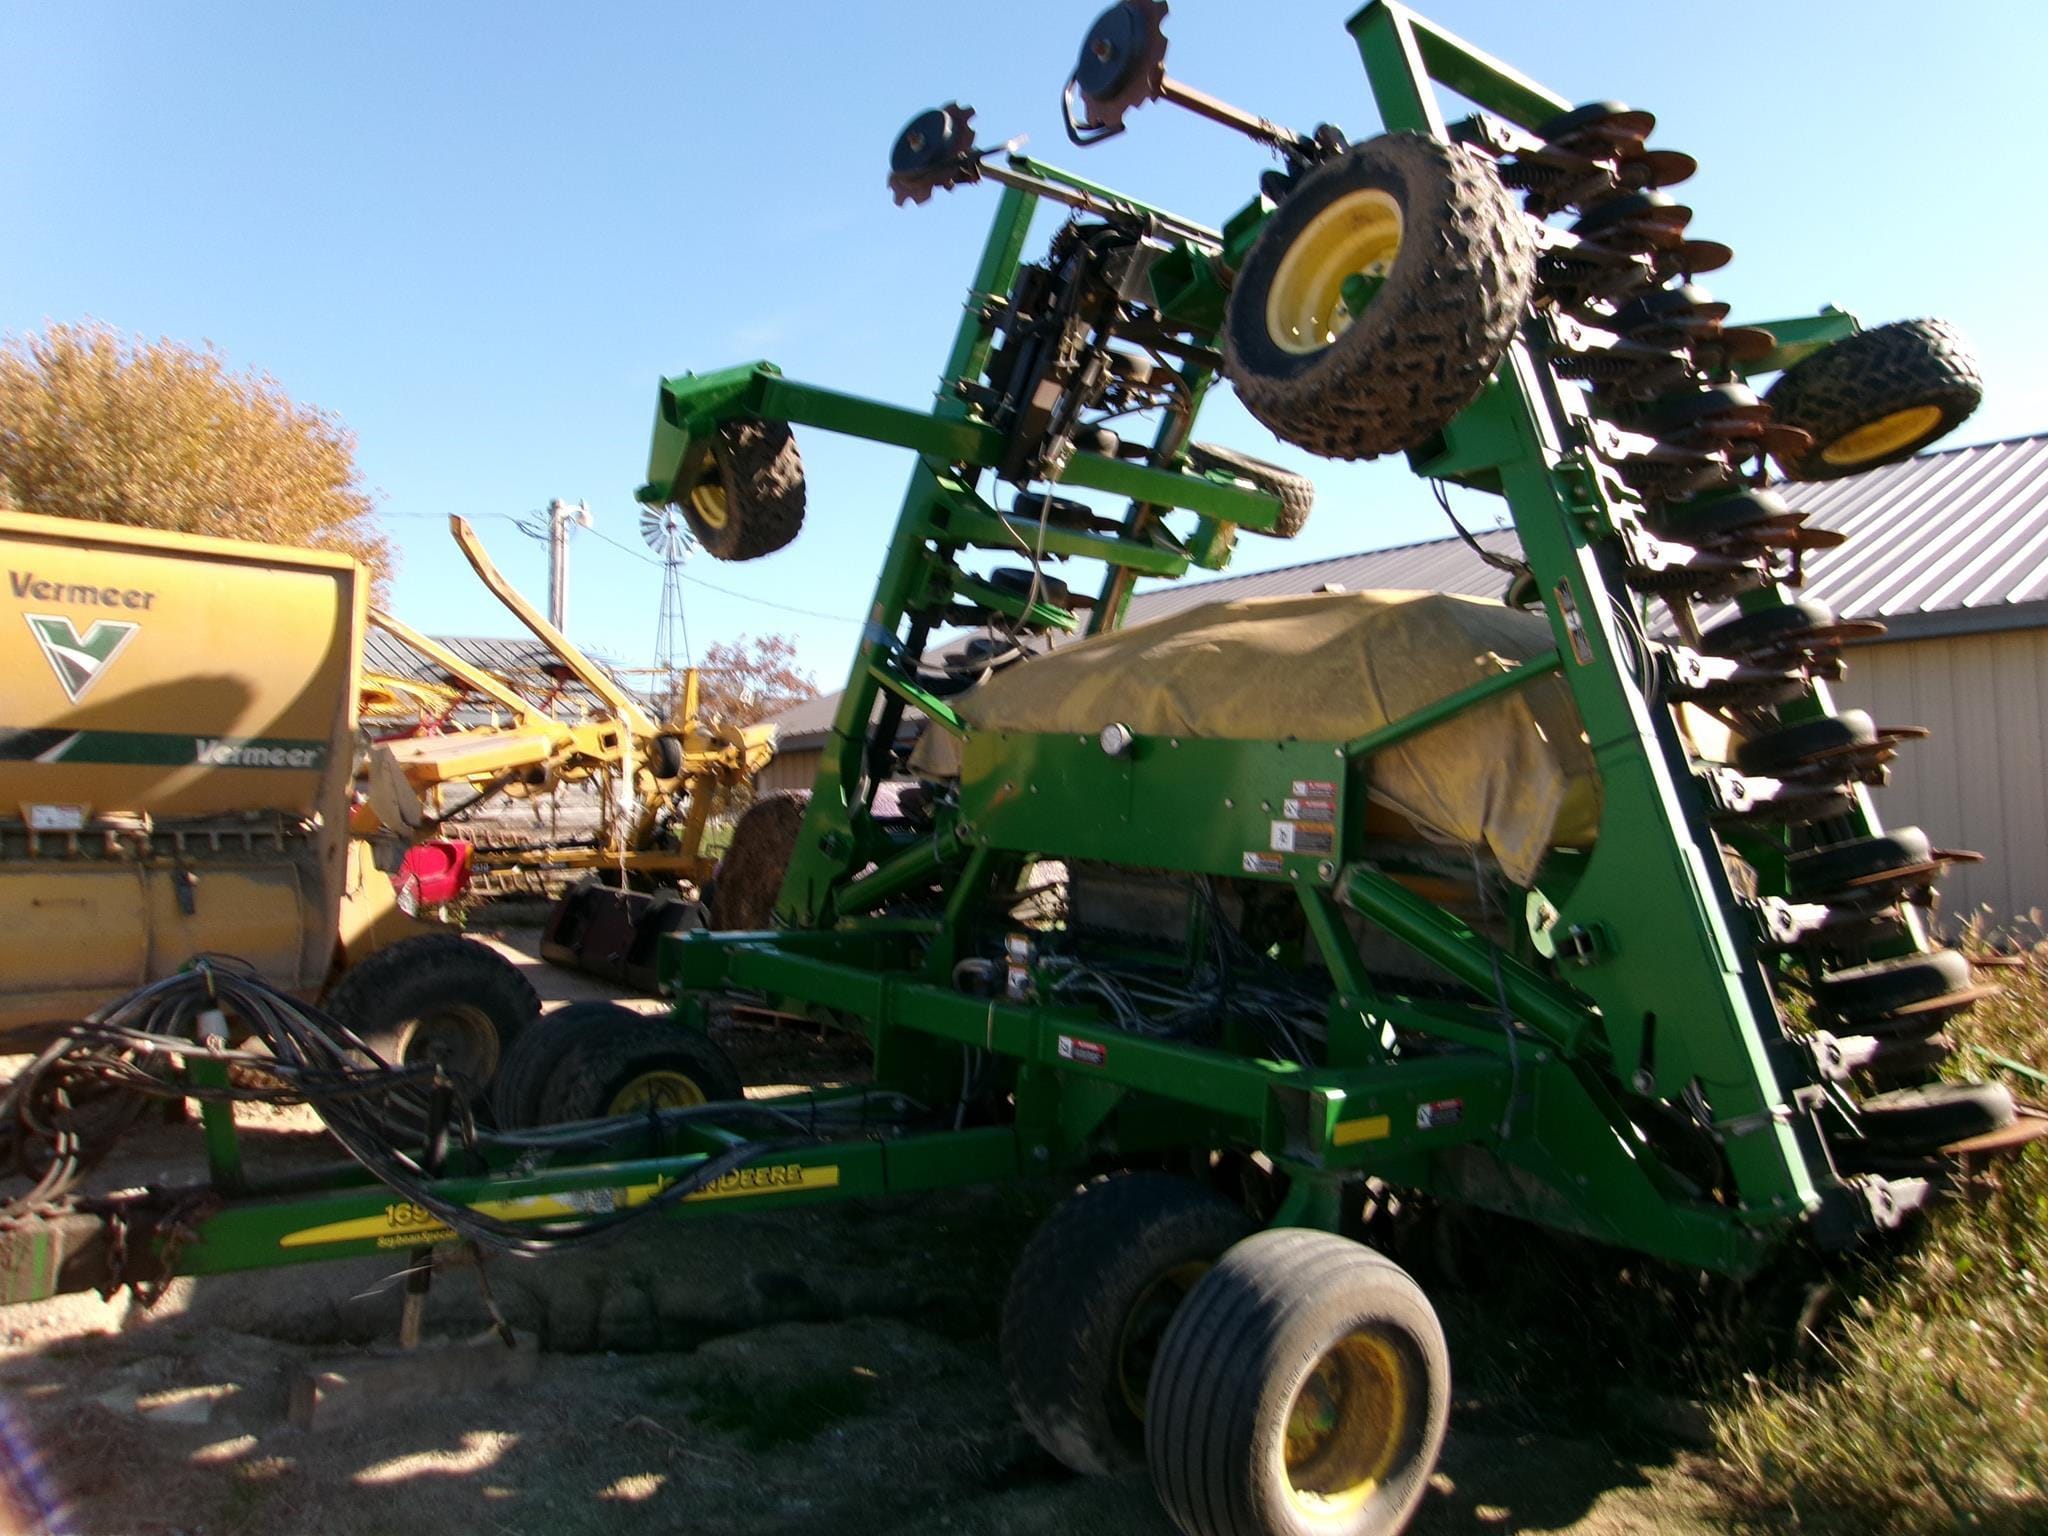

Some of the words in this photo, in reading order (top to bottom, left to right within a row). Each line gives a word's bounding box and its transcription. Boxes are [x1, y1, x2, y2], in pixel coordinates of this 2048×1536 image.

[8, 569, 155, 610] Vermeer
[195, 738, 318, 767] Vermeer
[720, 1163, 804, 1192] DEERE
[384, 1201, 431, 1228] 169
